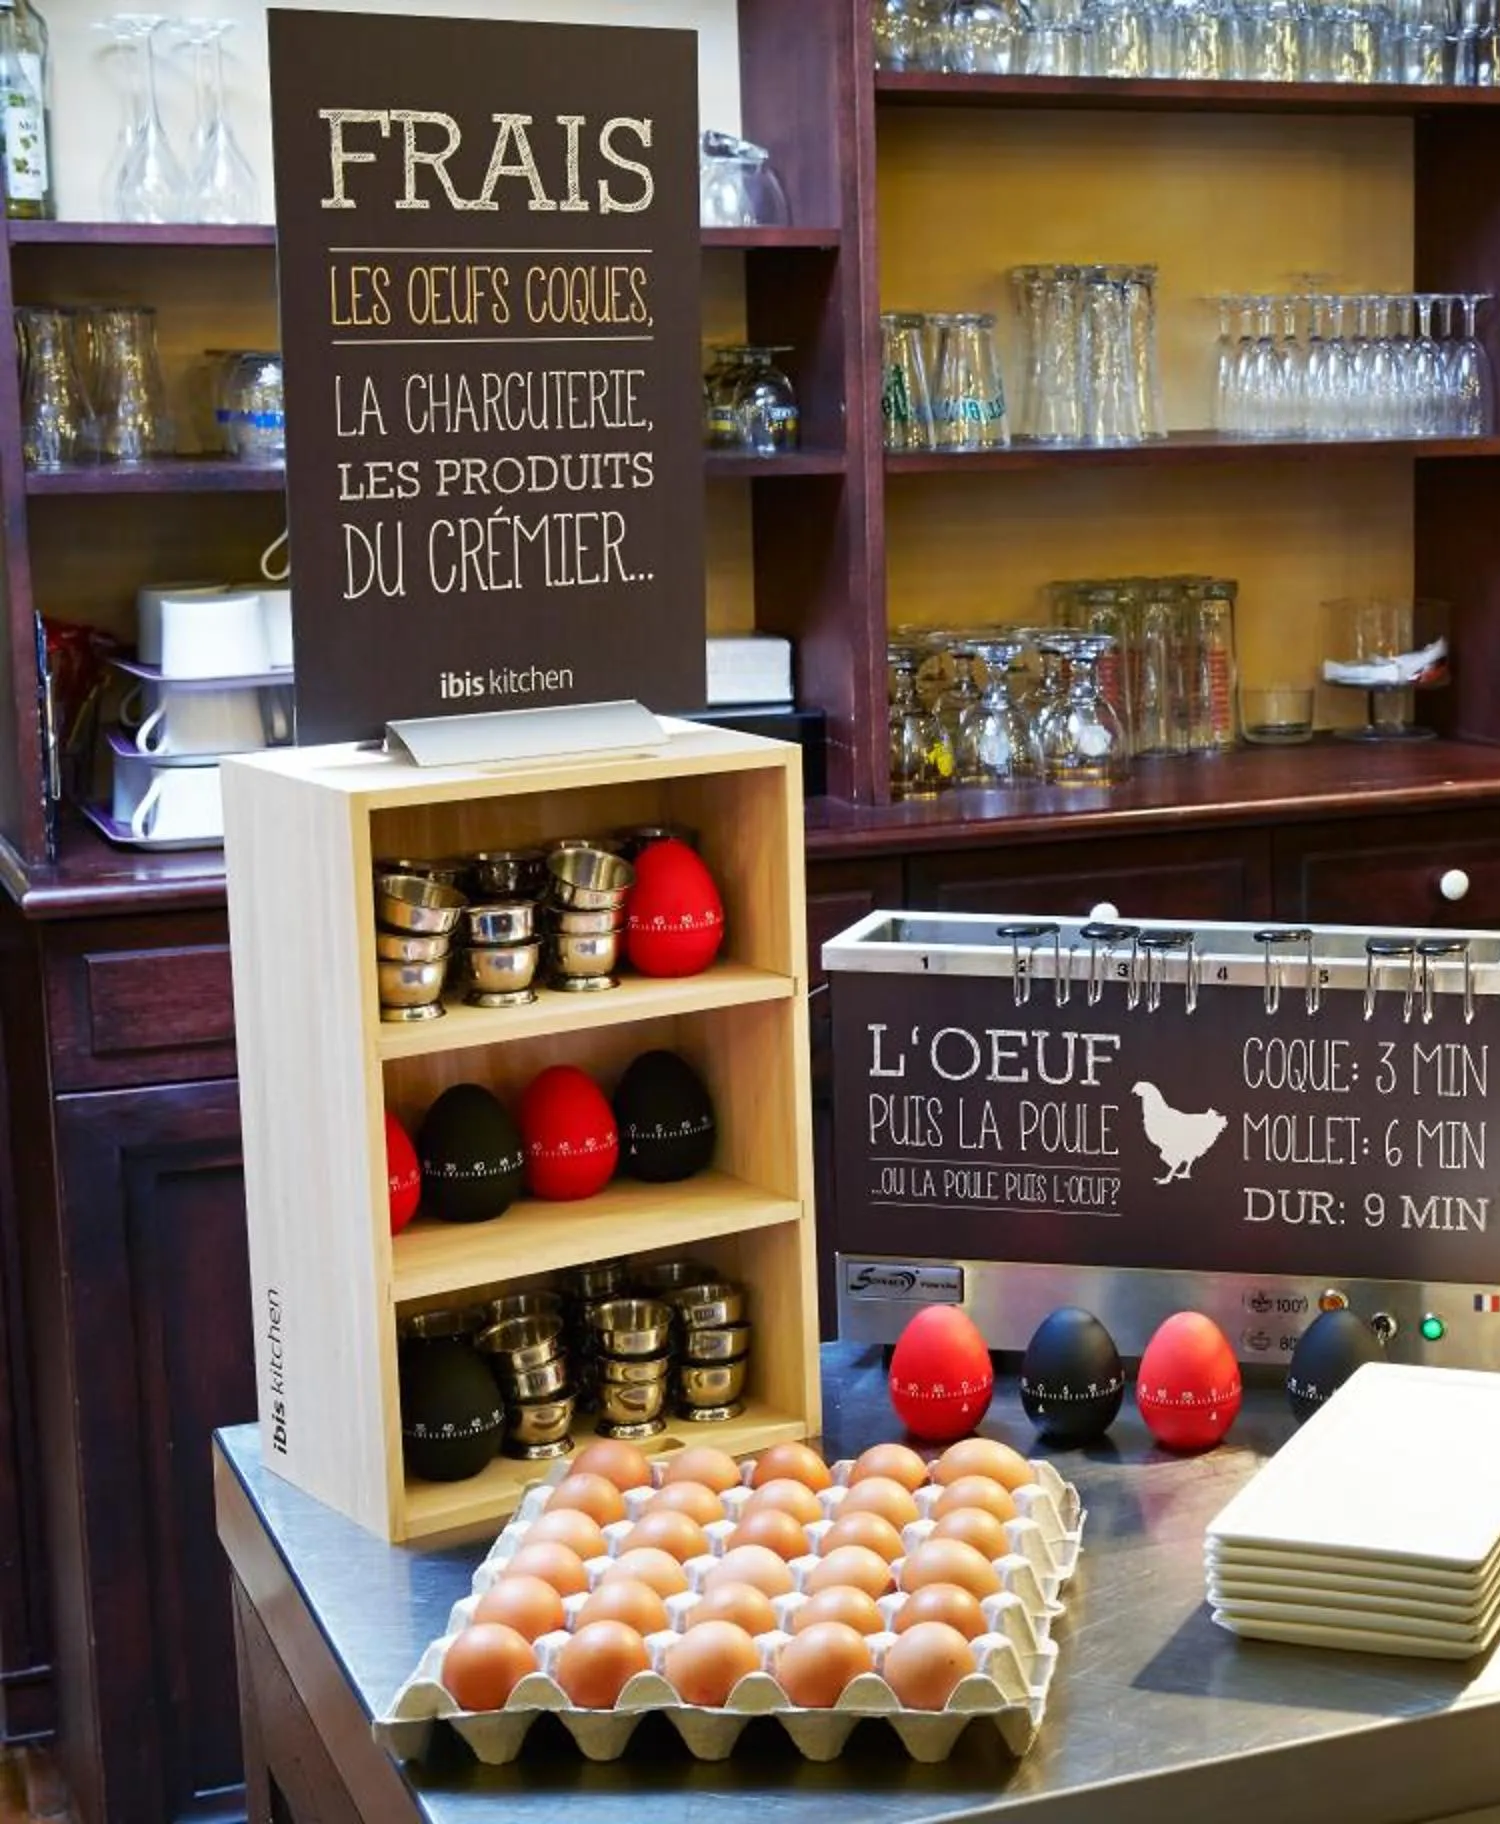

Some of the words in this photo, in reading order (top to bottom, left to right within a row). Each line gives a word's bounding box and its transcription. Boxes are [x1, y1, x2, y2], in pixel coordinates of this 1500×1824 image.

[318, 108, 655, 214] FRAIS
[331, 266, 391, 325] LES
[525, 265, 654, 328] COQUES,
[335, 375, 388, 437] LA
[405, 369, 654, 433] CHARCUTERIE,
[338, 461, 421, 501] LES
[436, 452, 655, 497] PRODUITS
[342, 521, 406, 600] DU
[440, 671, 485, 699] ibis
[489, 665, 573, 695] kitchen
[921, 956, 929, 970] 1
[1117, 963, 1129, 977] 3
[1216, 965, 1229, 981] 4
[1319, 969, 1329, 984] 5
[1243, 1037, 1359, 1093] COQUE:
[1375, 1041, 1397, 1094] 3
[1413, 1041, 1489, 1097] MIN
[868, 1093, 943, 1147] PUIS
[959, 1097, 1003, 1150] LA
[1019, 1100, 1120, 1156] POULE
[1243, 1112, 1369, 1166] MOLLET:
[1385, 1119, 1402, 1167] 6
[1417, 1119, 1487, 1169] MIN
[911, 1167, 937, 1197] LA
[944, 1169, 999, 1200] POULE
[1005, 1172, 1048, 1203] PUIS
[1243, 1187, 1345, 1225] DUR:
[1364, 1192, 1385, 1227] 9
[1400, 1194, 1490, 1232] MIN
[267, 1288, 284, 1395] kitchen
[271, 1400, 287, 1455] ibis
